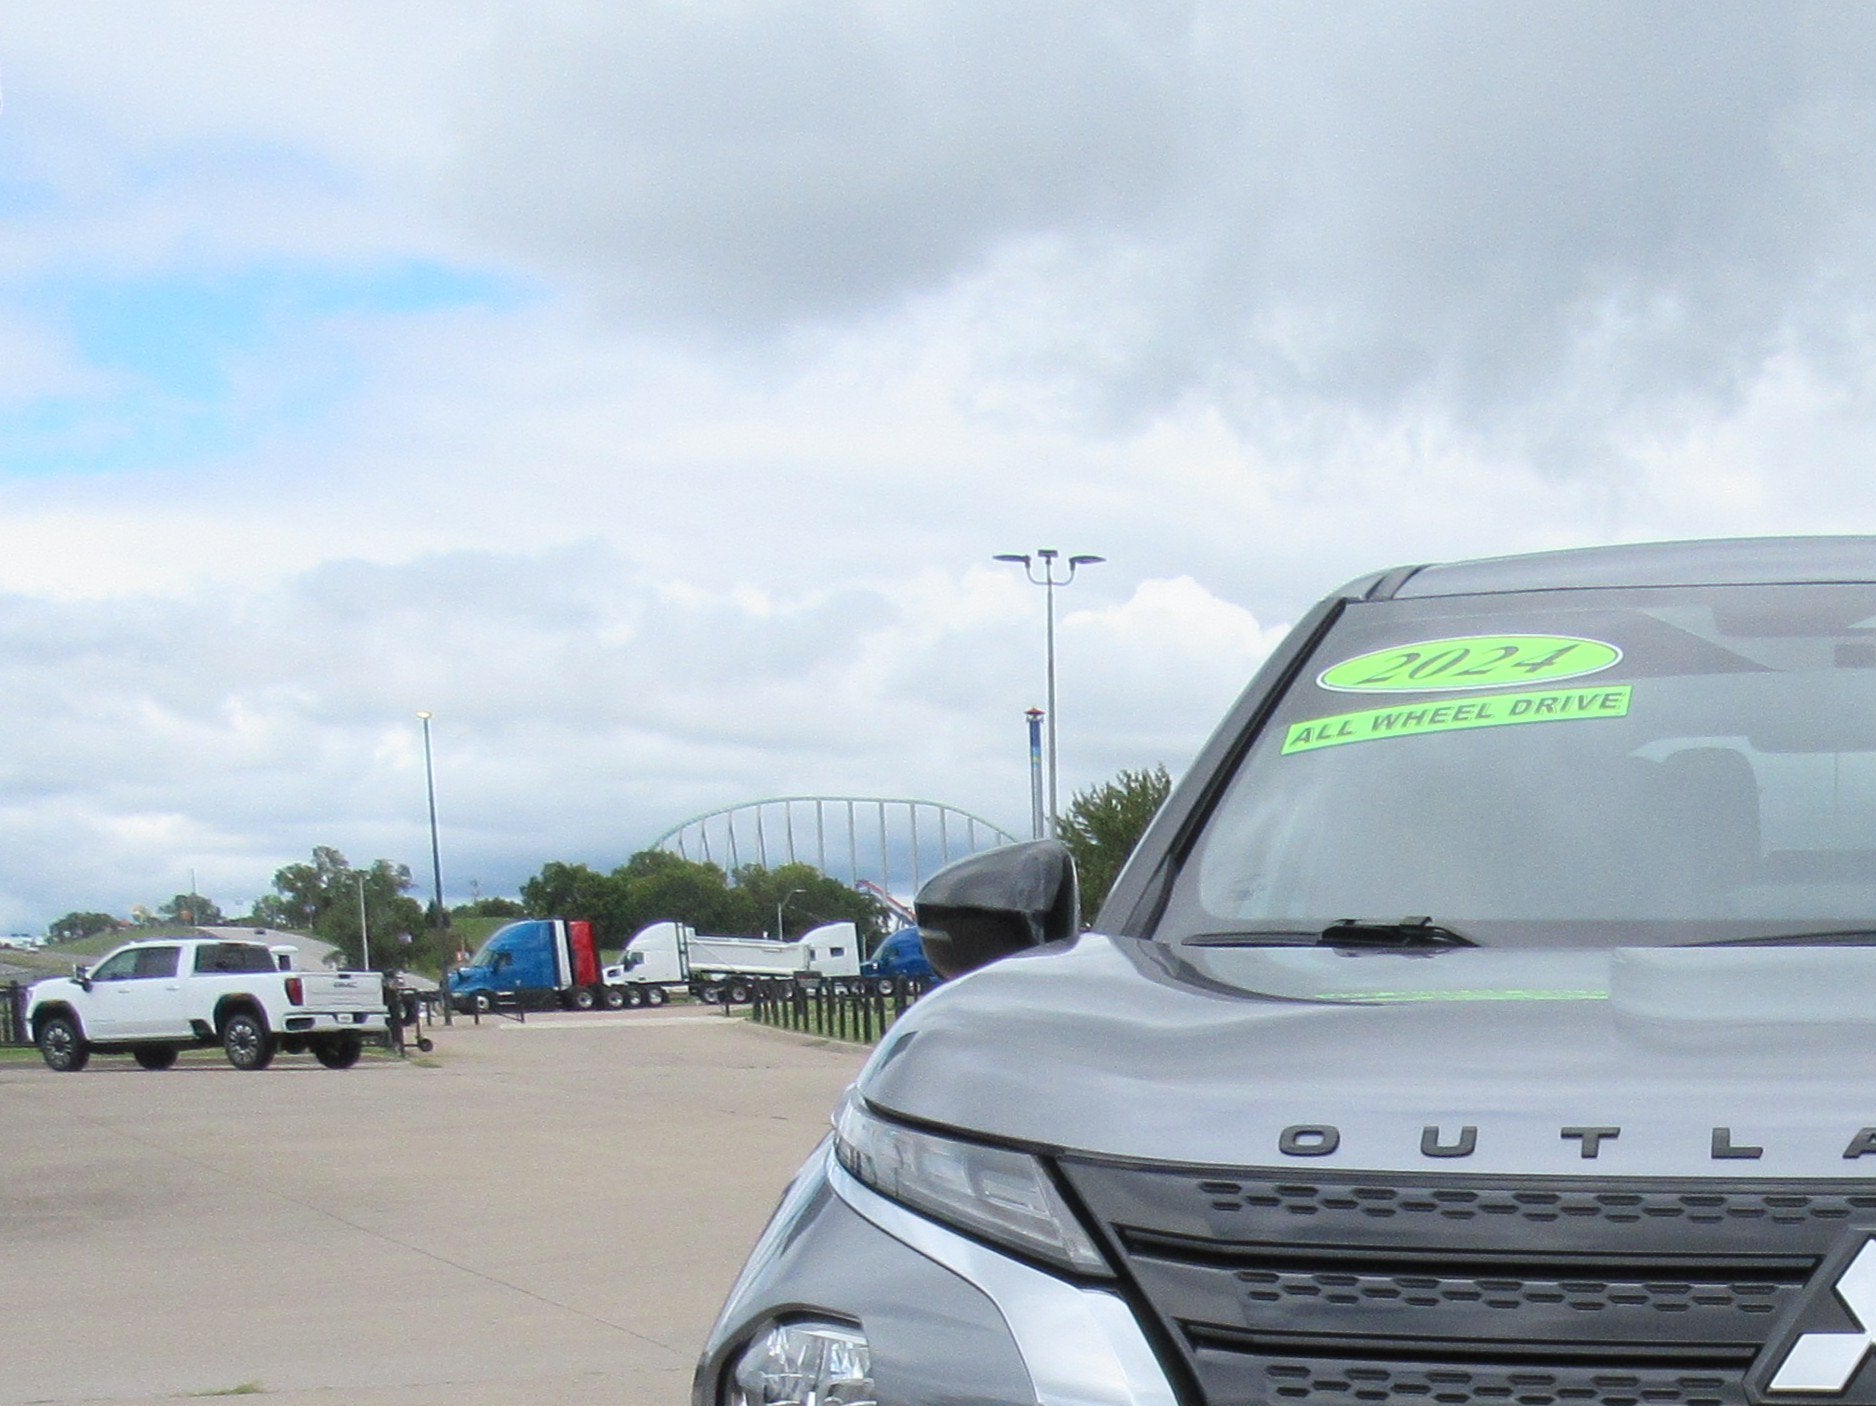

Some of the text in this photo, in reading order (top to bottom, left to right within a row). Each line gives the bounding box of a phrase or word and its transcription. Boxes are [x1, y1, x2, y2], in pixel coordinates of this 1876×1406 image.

[1353, 644, 1581, 685] 2024
[1290, 692, 1625, 746] ALL WHEEL DRIVE
